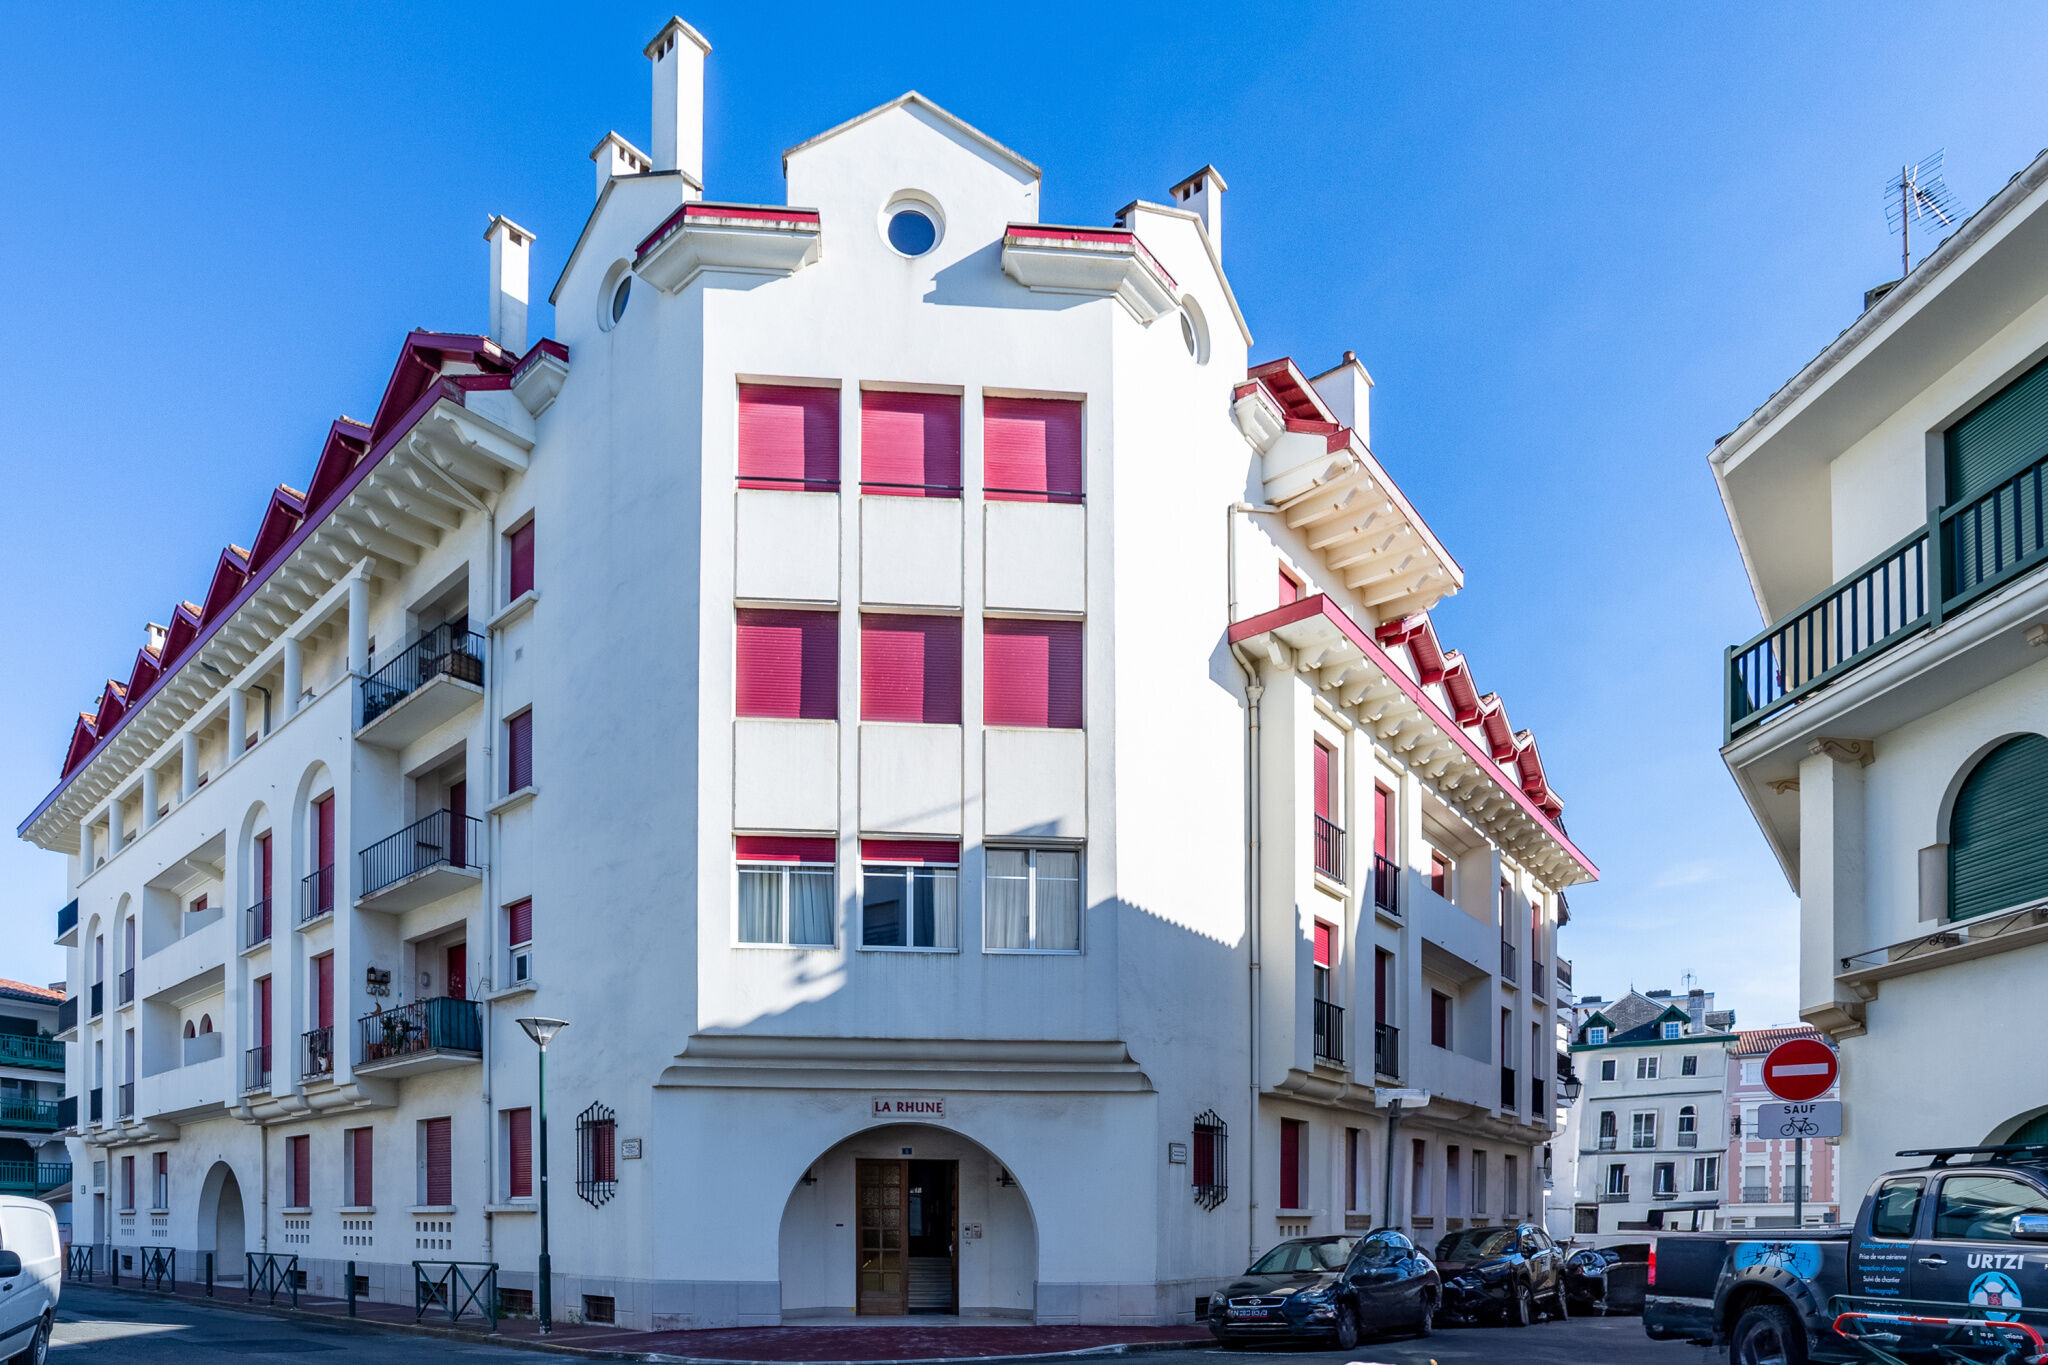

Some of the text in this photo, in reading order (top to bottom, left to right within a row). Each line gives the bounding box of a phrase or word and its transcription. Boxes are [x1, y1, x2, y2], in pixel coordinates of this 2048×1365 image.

[875, 1101, 943, 1113] LA RHUNE
[1783, 1104, 1817, 1114] SAUF
[1967, 1253, 2025, 1270] URTZI
